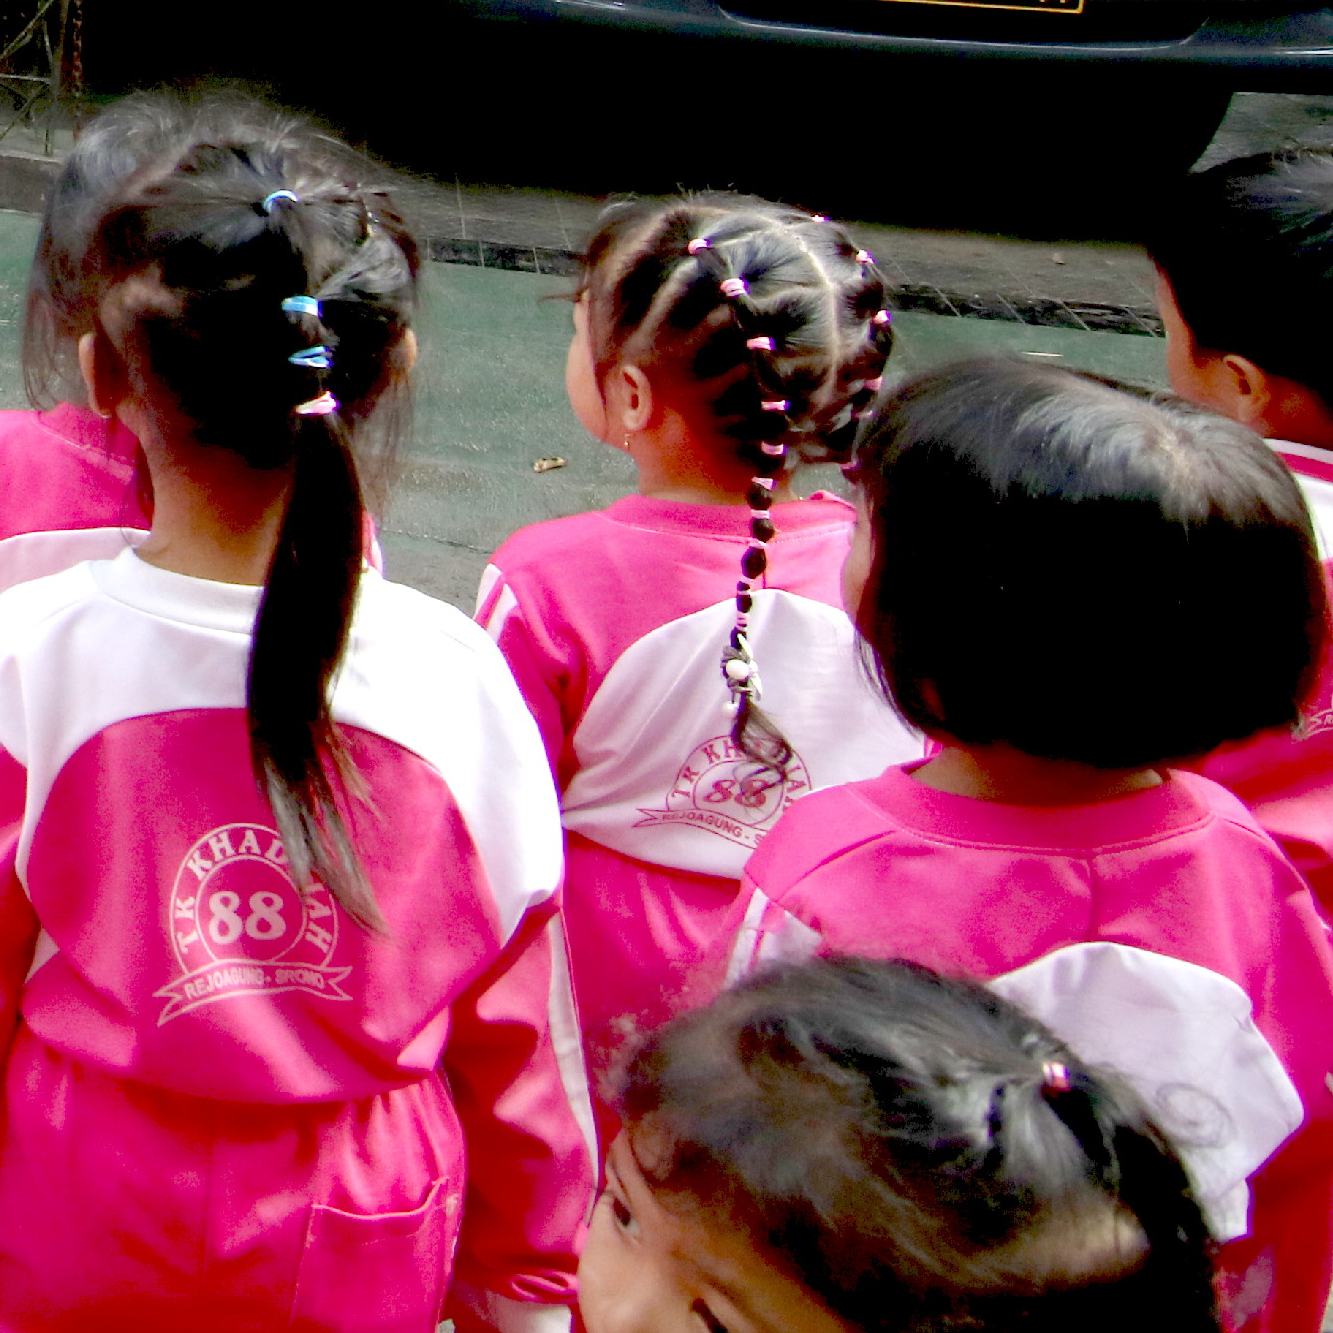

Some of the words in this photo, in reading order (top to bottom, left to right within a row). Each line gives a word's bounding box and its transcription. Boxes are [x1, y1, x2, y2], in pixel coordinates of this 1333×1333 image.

[703, 779, 767, 808] 88
[208, 891, 287, 944] 88
[184, 967, 264, 1000] REJOAGUNG
